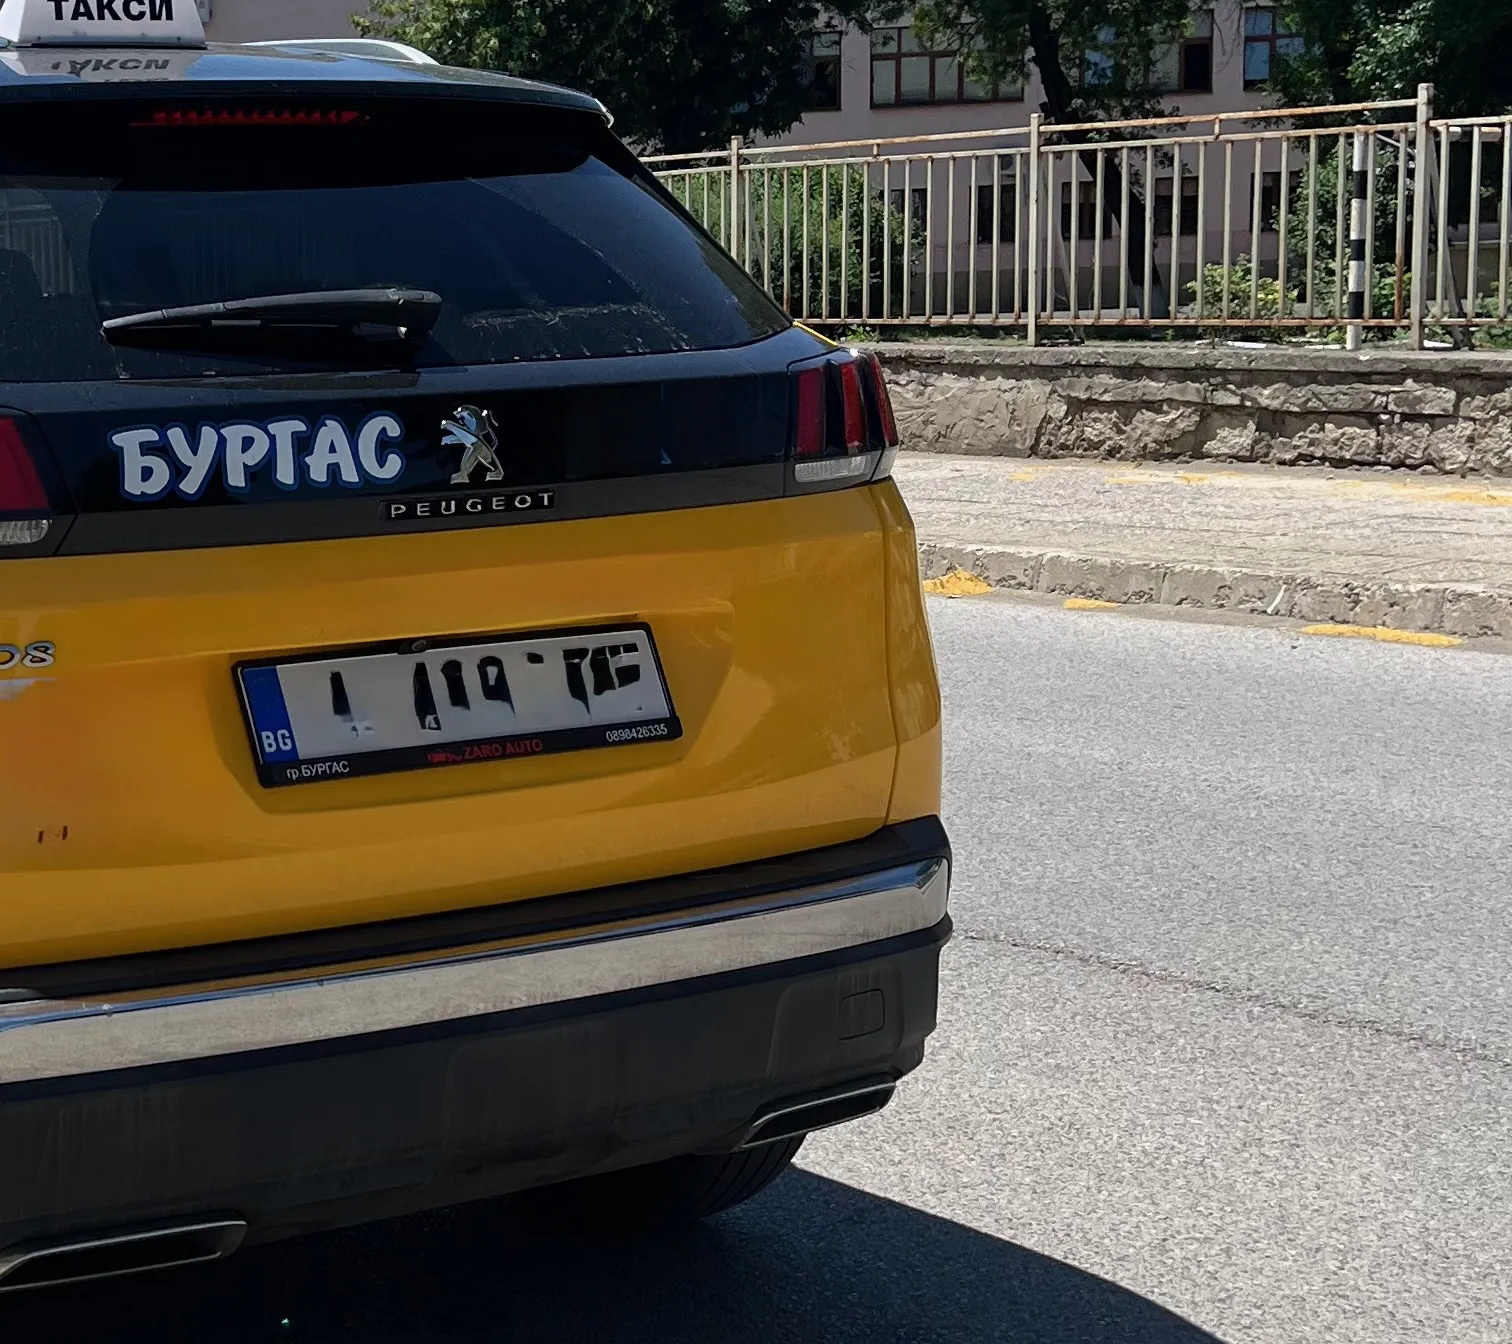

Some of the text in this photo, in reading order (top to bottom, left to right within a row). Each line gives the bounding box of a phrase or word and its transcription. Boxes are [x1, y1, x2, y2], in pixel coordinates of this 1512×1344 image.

[110, 414, 403, 497] БУРГАС
[390, 492, 554, 518] PEUGEOT
[261, 729, 293, 753] BG
[505, 739, 543, 754] AUTO
